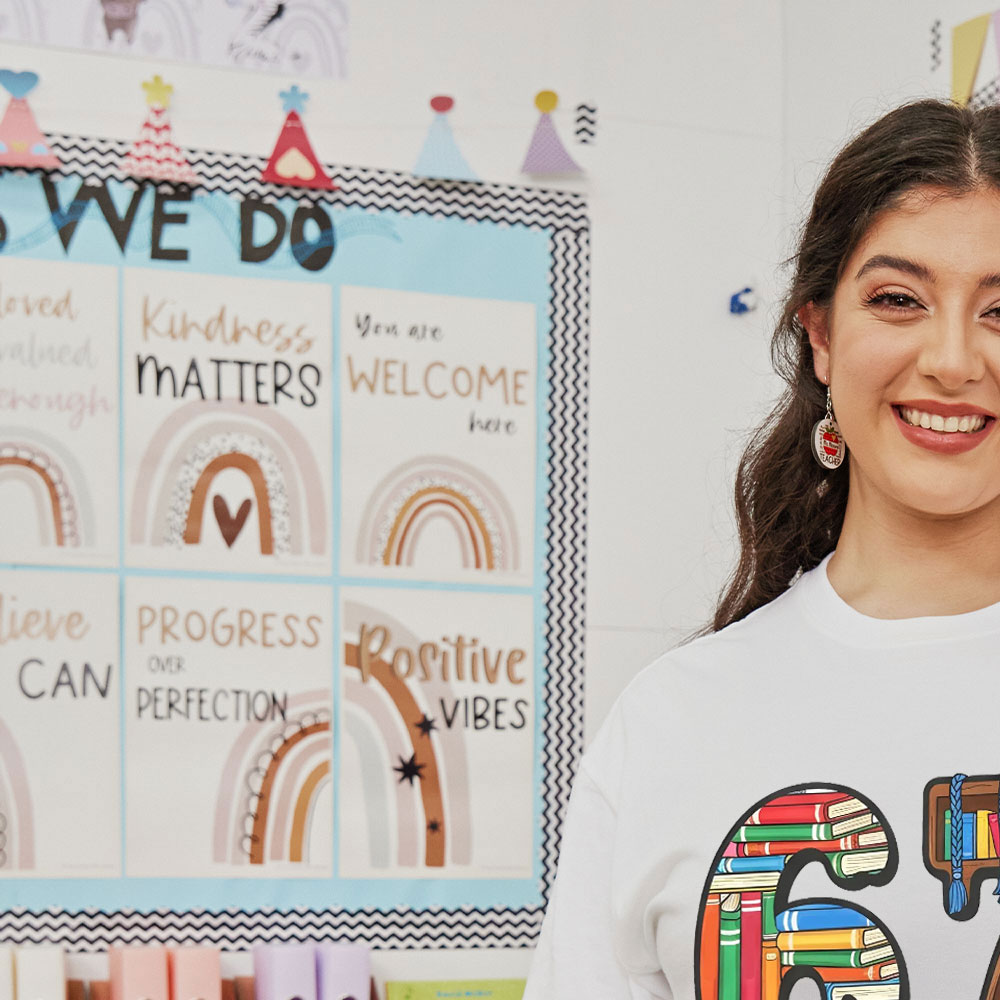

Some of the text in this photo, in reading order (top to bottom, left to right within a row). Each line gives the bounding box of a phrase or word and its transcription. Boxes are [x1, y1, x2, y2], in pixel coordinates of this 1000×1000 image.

[40, 174, 193, 261] WE
[239, 192, 335, 271] DO
[141, 294, 318, 355] Kindness
[354, 311, 445, 341] You are
[136, 353, 322, 408] MATTERS
[346, 353, 530, 407] WELCOME
[468, 409, 518, 436] here
[136, 604, 323, 649] PROGRESS
[148, 654, 187, 674] OVER
[358, 620, 527, 685] Positive
[18, 656, 113, 700] CAN
[136, 686, 288, 722] PERFECTION
[439, 696, 529, 731] VIBES
